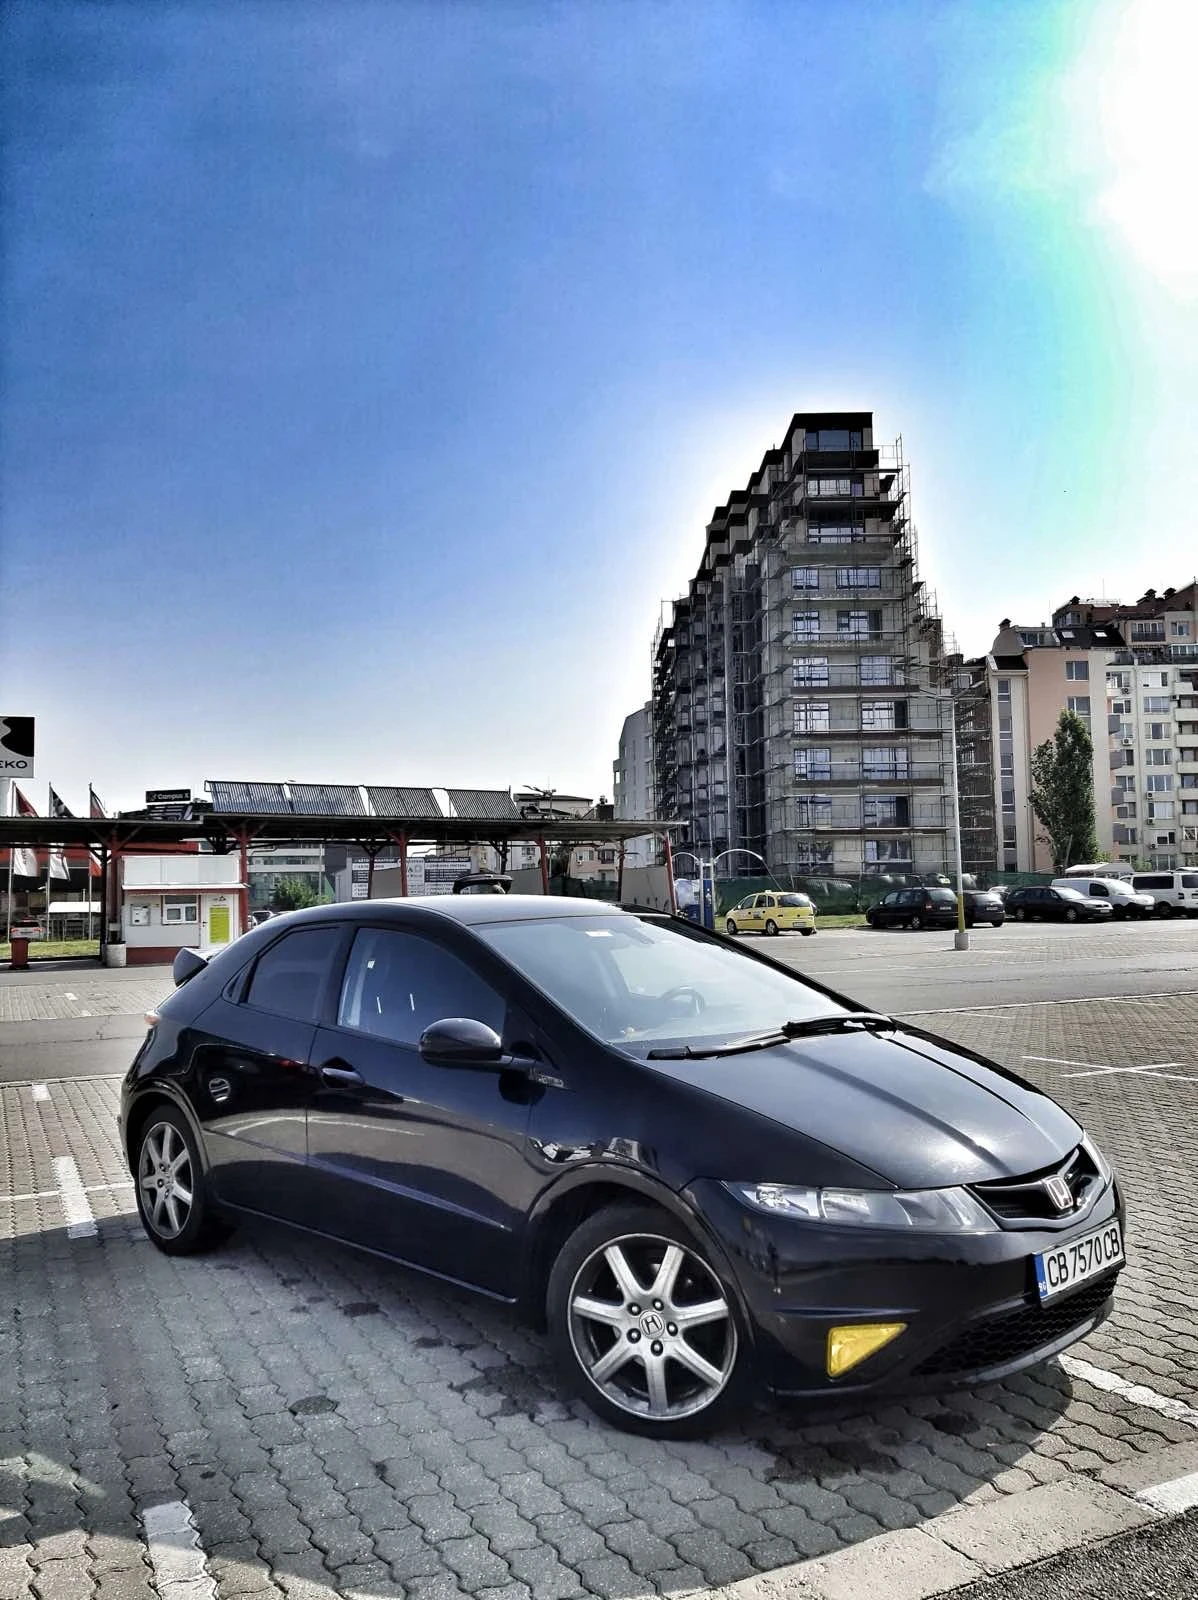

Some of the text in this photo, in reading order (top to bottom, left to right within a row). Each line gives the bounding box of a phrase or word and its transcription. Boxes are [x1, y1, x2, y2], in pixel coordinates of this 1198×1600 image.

[1047, 1228, 1120, 1287] CB 7570 CB
